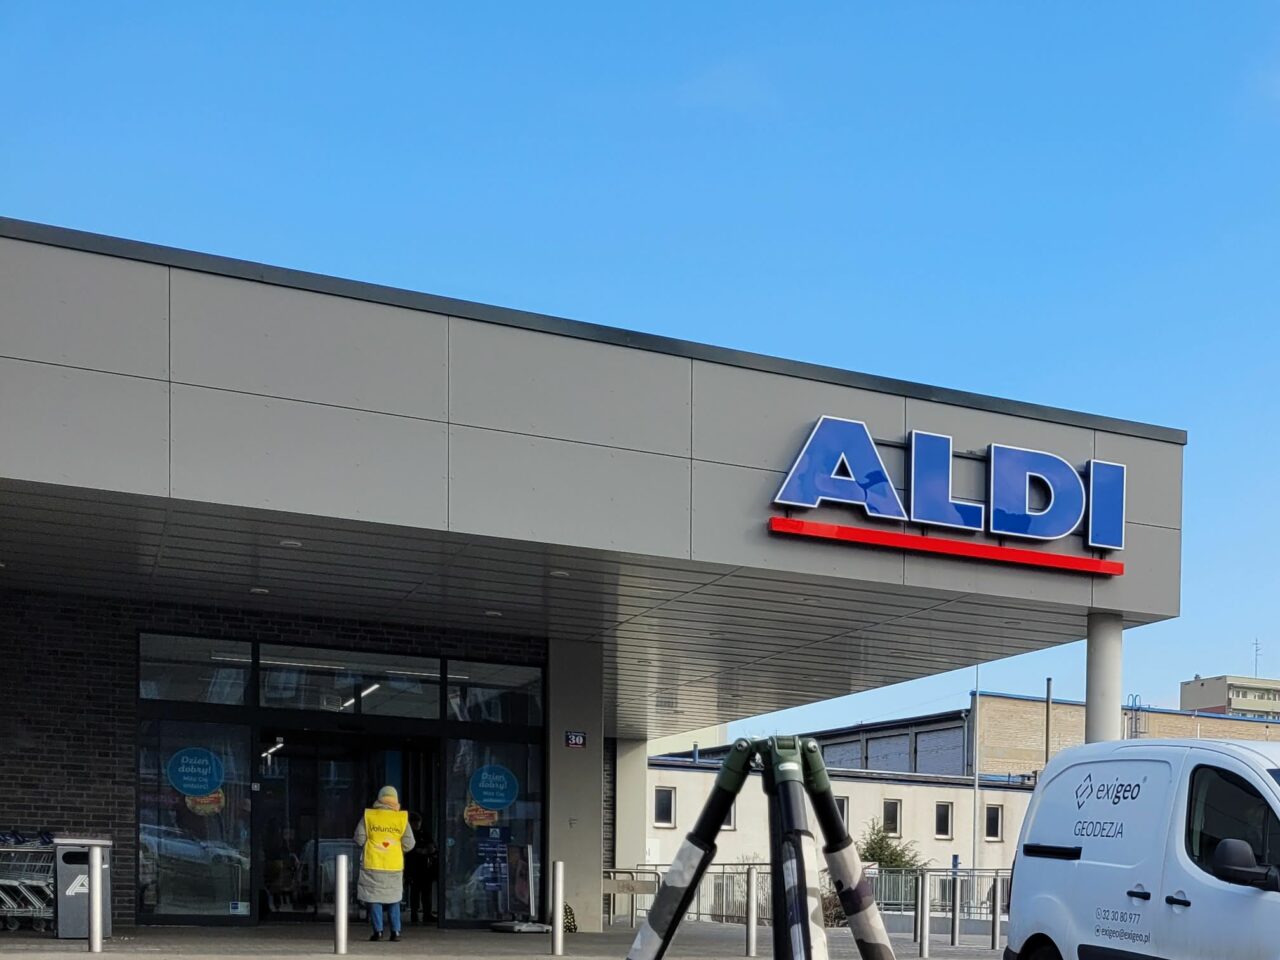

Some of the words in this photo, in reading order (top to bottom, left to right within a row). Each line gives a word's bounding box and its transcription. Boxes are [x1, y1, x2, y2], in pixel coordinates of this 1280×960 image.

[774, 415, 1126, 550] ALDI
[568, 735, 583, 744] 30
[1096, 777, 1141, 804] exigeo
[1073, 820, 1124, 839] GEODEZJA
[1102, 909, 1109, 920] 32
[1110, 910, 1118, 921] 30
[1120, 911, 1128, 922] 80
[1128, 912, 1141, 924] 977
